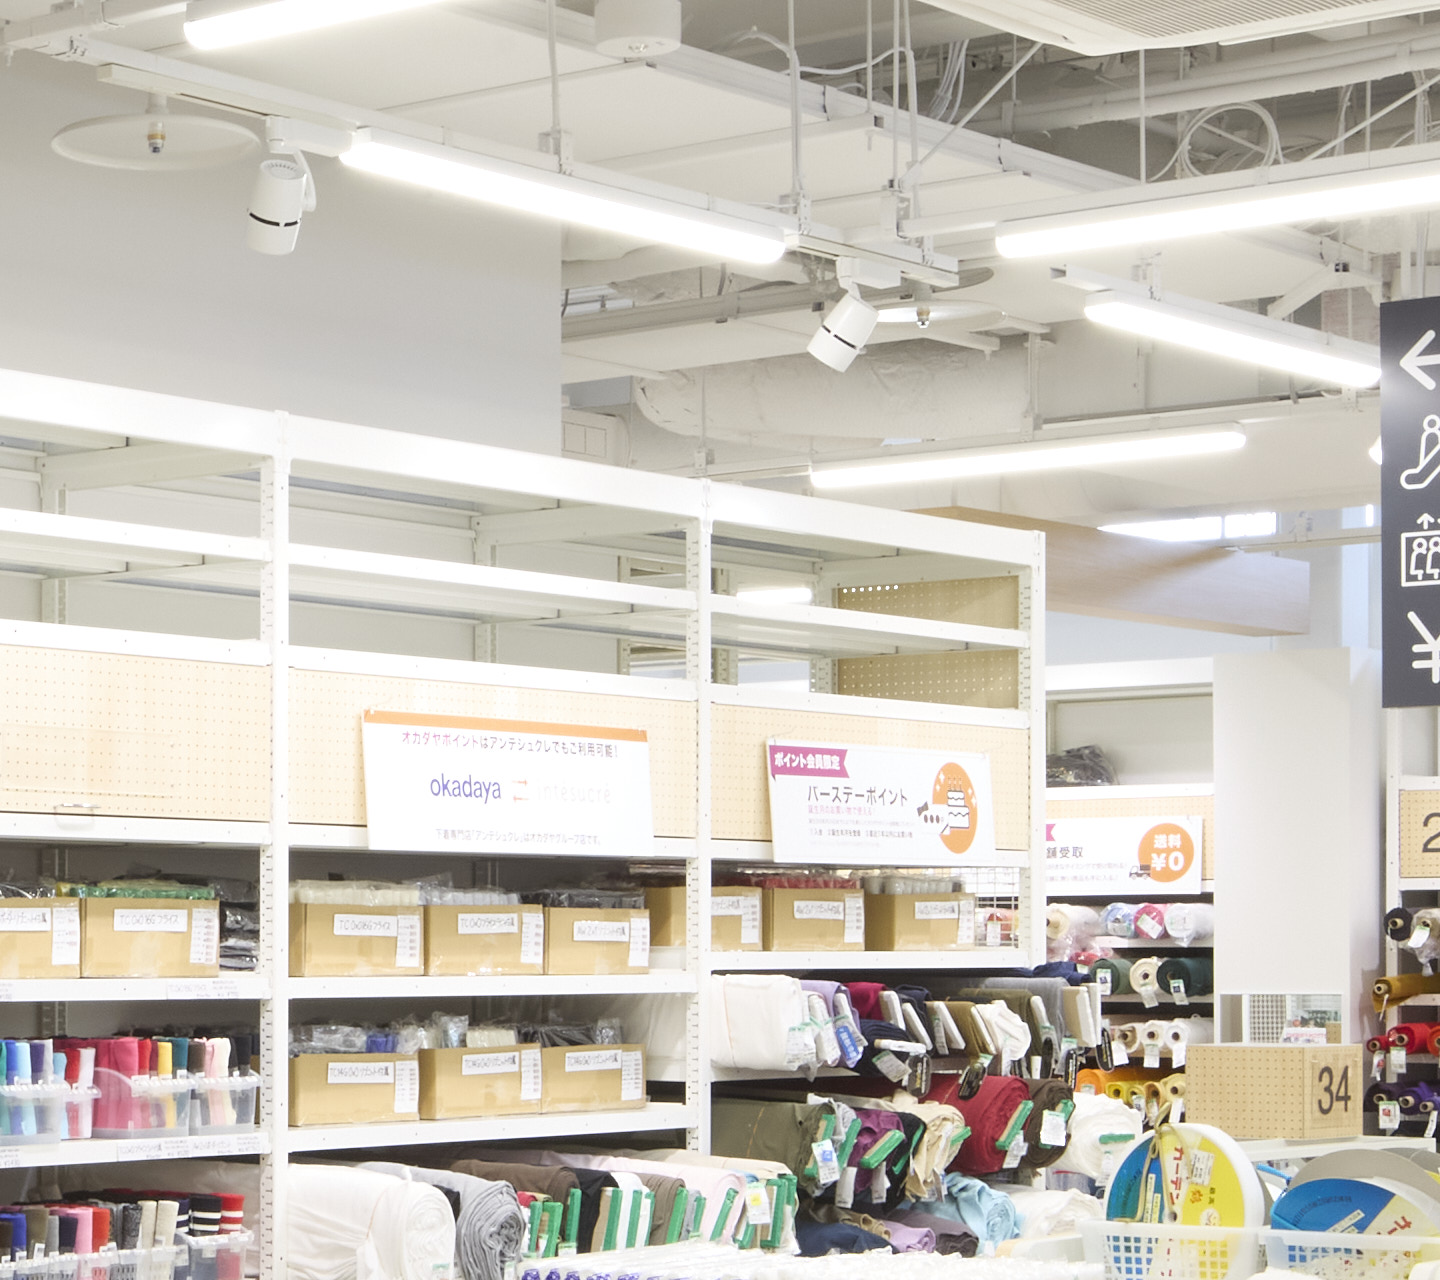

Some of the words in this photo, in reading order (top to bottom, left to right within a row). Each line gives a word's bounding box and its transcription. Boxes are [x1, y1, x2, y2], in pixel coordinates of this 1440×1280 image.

[774, 752, 840, 770] ポイント会員限定
[430, 773, 501, 804] okadaya
[808, 786, 908, 807] バースデーポイント
[1154, 834, 1182, 848] 送料
[1151, 851, 1185, 871] ¥0
[1317, 1066, 1352, 1116] 34
